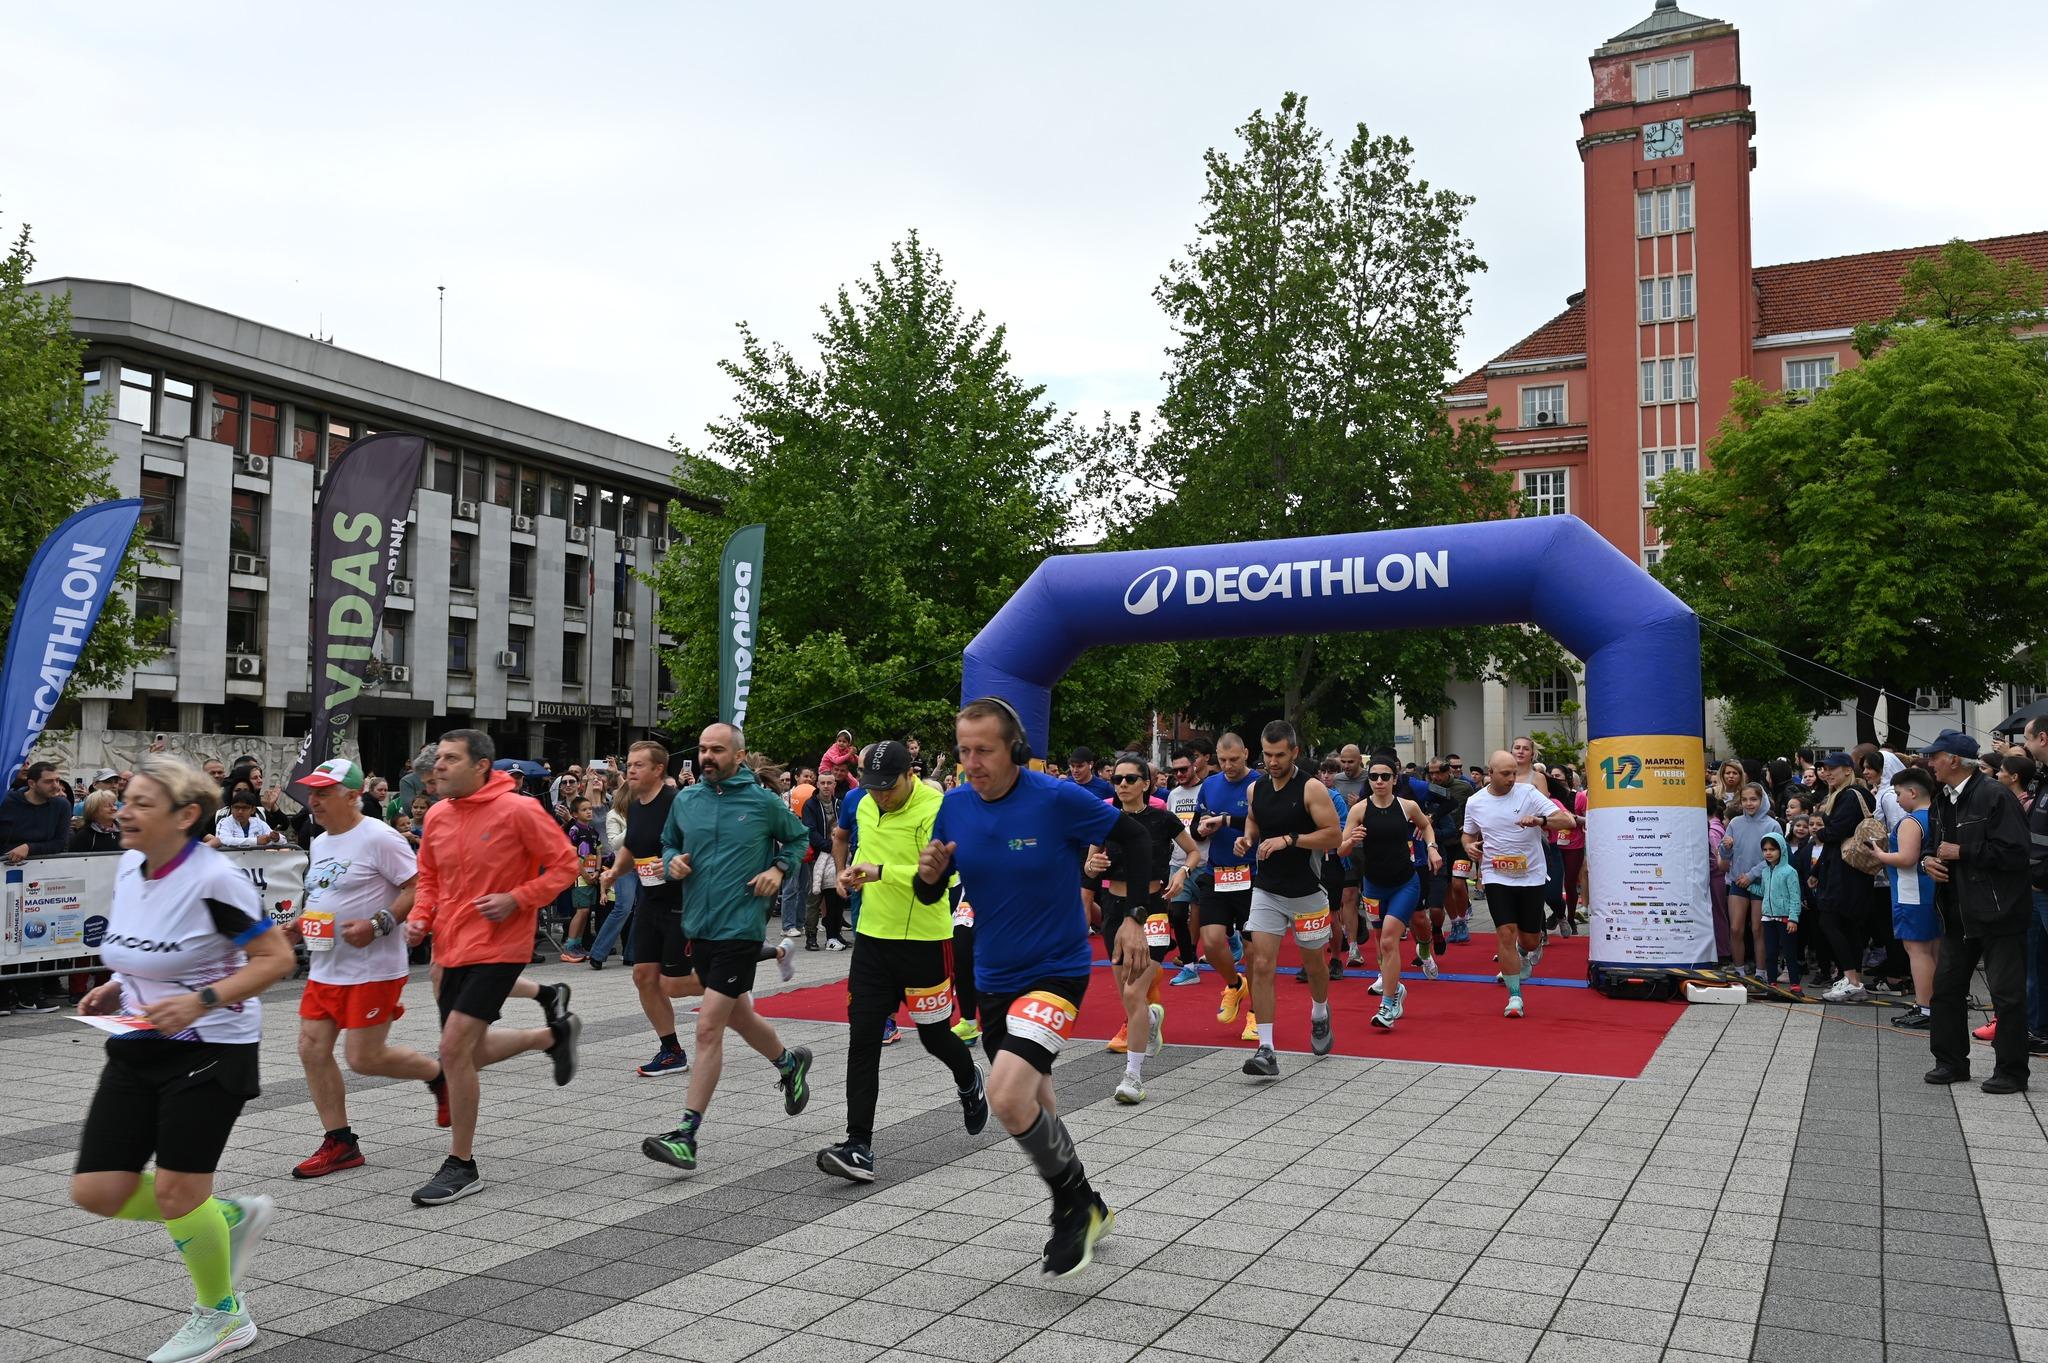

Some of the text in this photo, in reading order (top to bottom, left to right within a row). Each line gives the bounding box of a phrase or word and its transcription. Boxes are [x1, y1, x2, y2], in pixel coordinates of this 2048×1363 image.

[1185, 551, 1449, 605] DECATHLON
[325, 512, 382, 710] VIDAS
[1600, 755, 1643, 789] 12
[1495, 861, 1514, 869] 109
[1220, 872, 1243, 882] 488
[25, 897, 77, 906] MAGNESIUM
[302, 920, 321, 936] 513
[1144, 920, 1165, 934] 464
[1303, 917, 1326, 930] 467
[916, 994, 947, 1010] 496
[1022, 1001, 1066, 1031] 449
